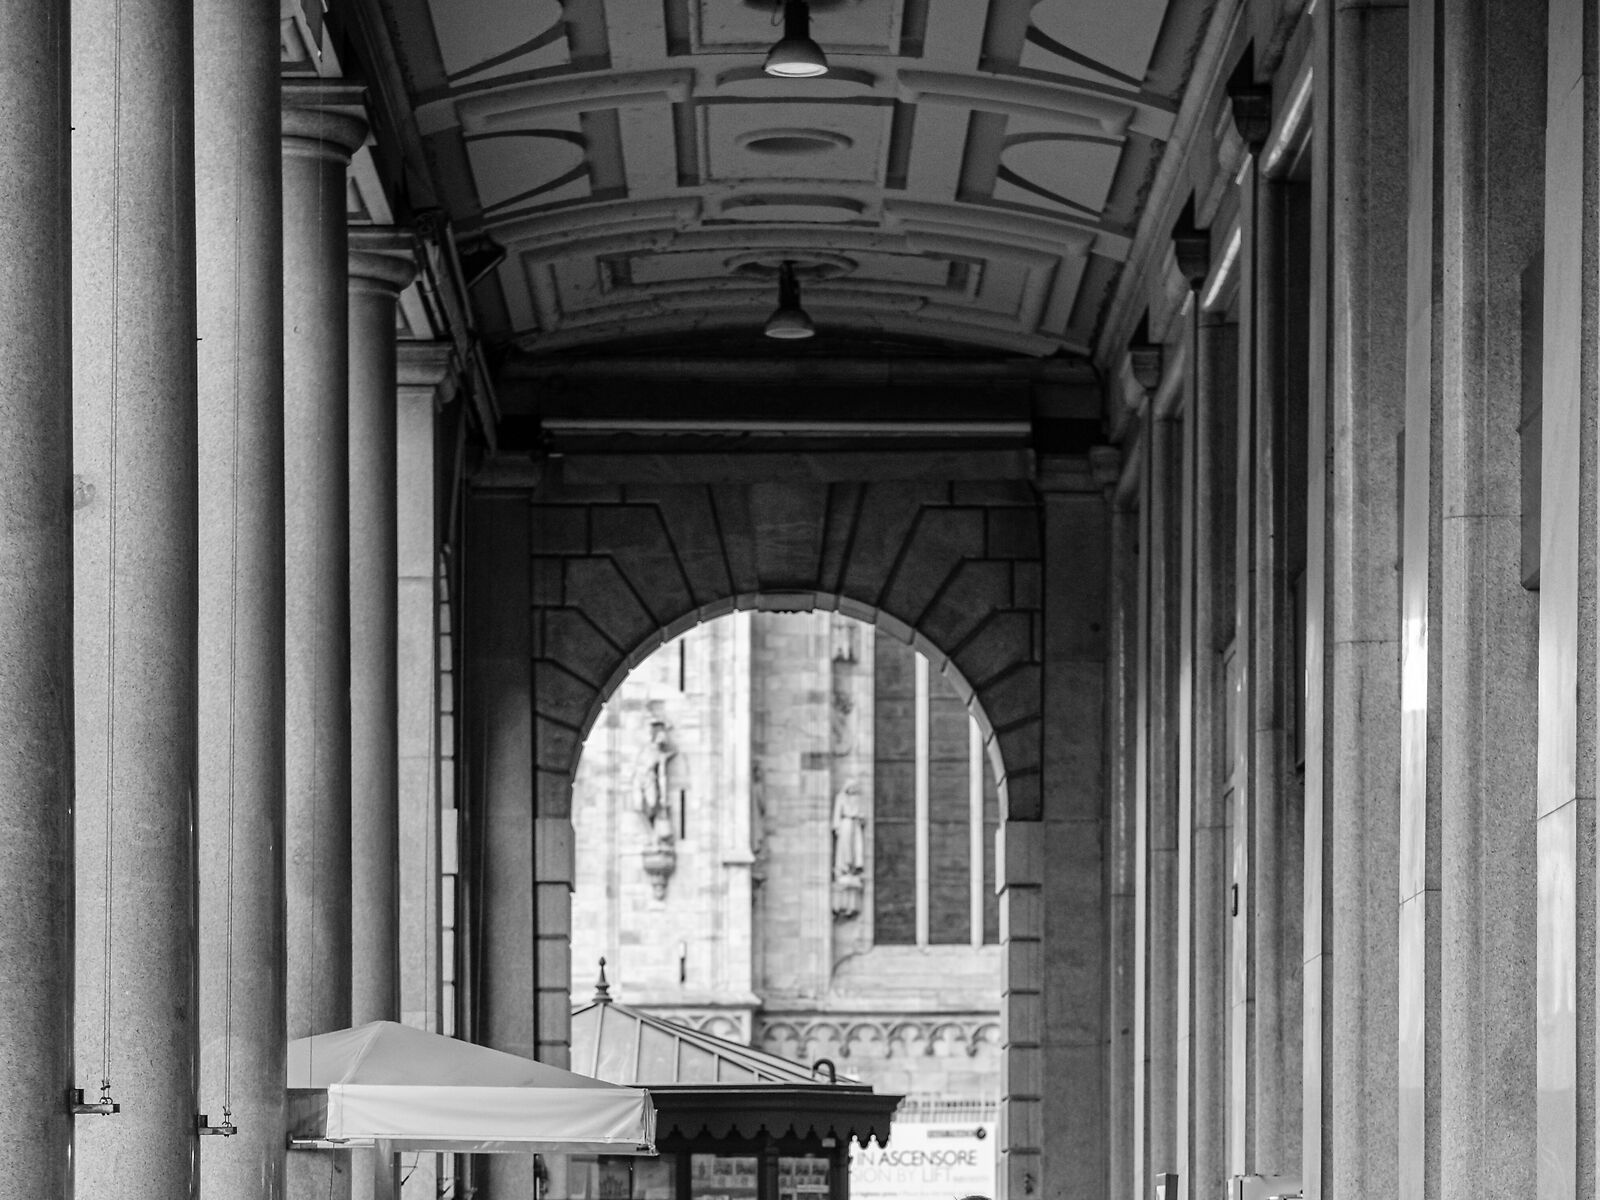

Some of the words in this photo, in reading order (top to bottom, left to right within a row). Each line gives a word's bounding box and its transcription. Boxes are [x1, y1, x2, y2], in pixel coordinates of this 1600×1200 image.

[857, 1151, 874, 1165] IN
[878, 1149, 977, 1166] ASCENSORE
[897, 1167, 916, 1183] BY
[922, 1167, 952, 1183] LIFT
